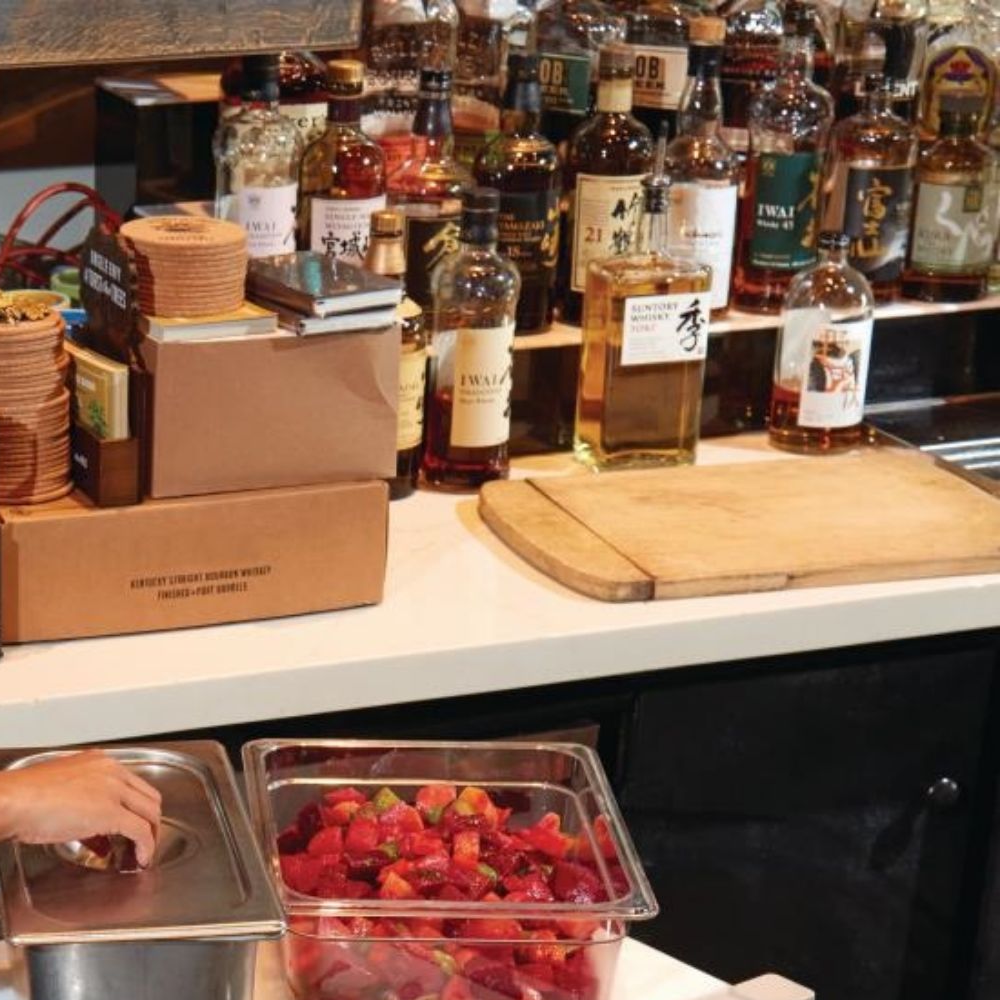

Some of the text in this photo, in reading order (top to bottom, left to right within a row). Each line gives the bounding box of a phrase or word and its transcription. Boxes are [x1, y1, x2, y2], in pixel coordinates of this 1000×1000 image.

[758, 203, 795, 219] IWAI
[246, 221, 277, 231] IWAI
[584, 226, 603, 243] 21
[631, 302, 679, 313] SUNTORY
[676, 297, 706, 352] 季
[460, 373, 498, 387] IWAI
